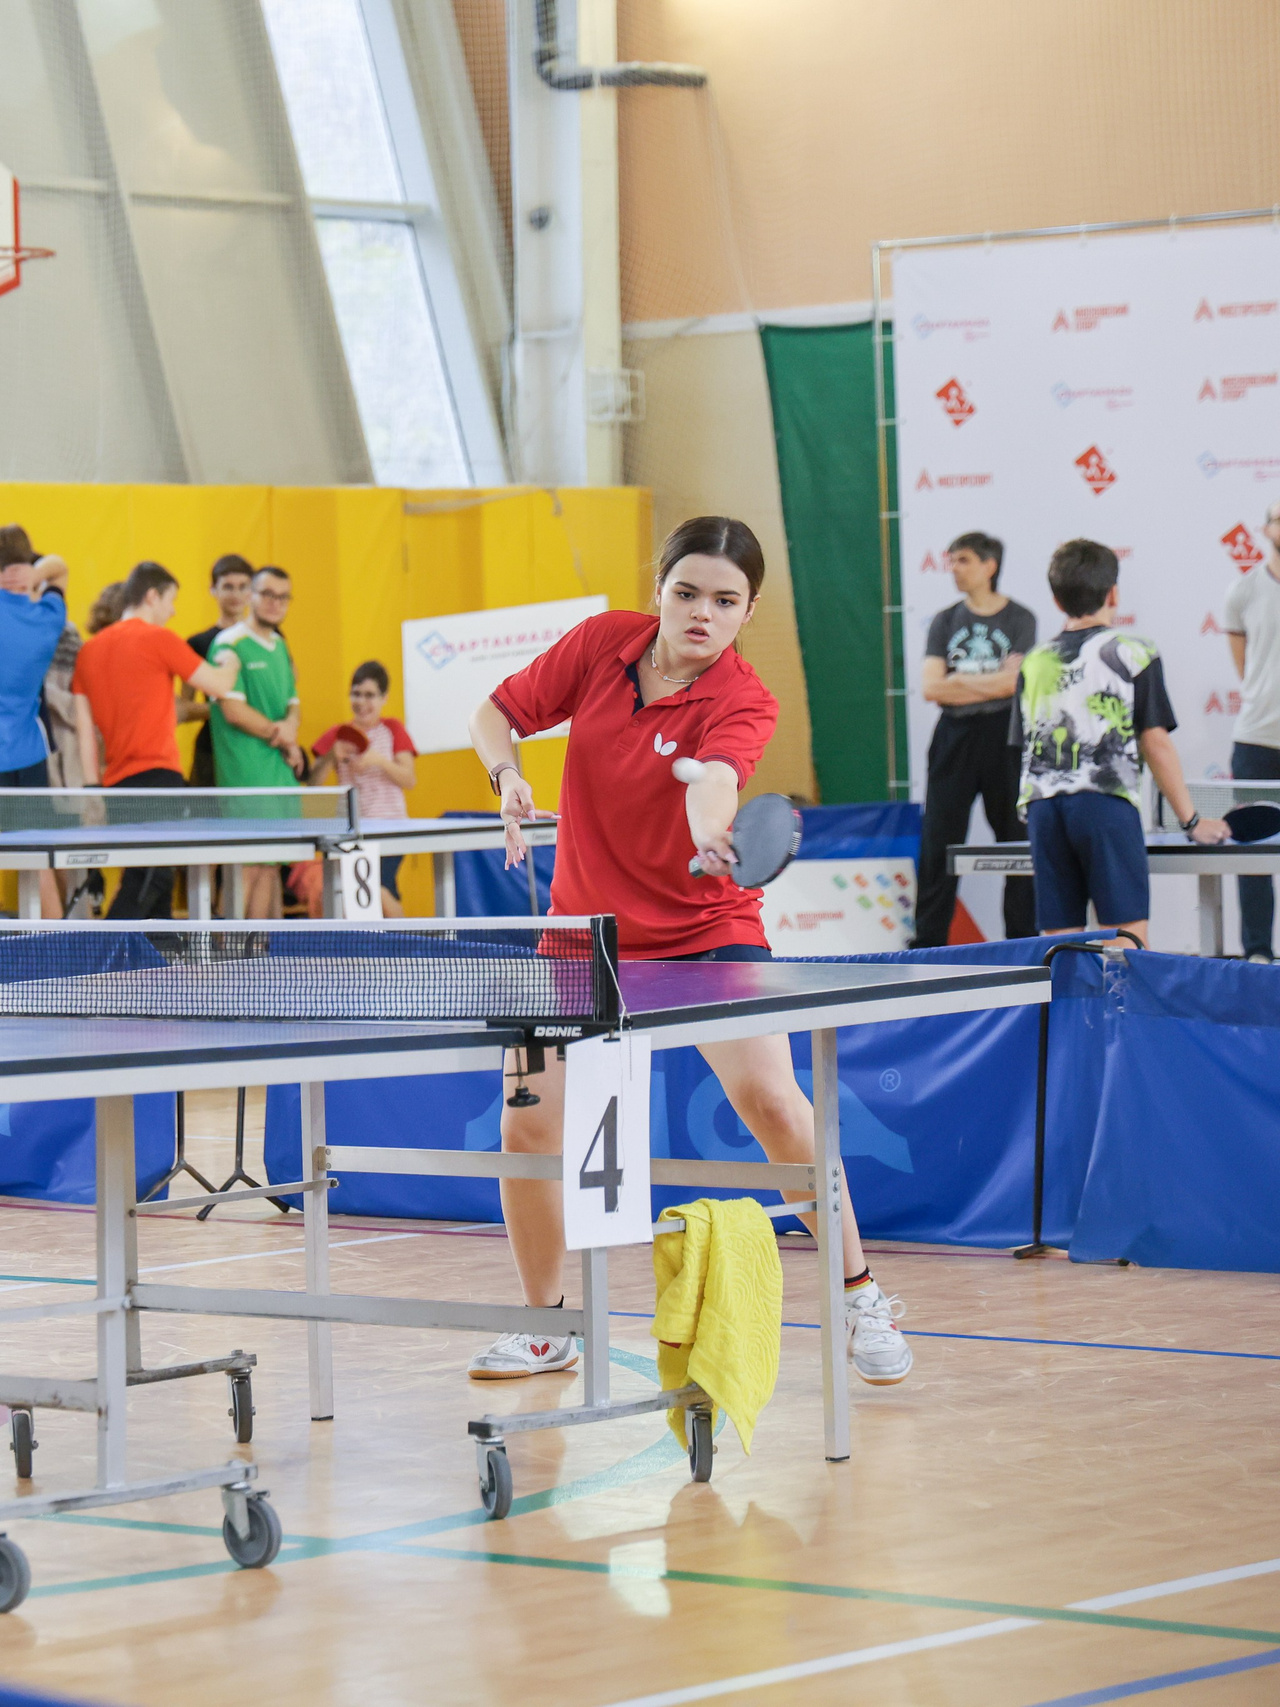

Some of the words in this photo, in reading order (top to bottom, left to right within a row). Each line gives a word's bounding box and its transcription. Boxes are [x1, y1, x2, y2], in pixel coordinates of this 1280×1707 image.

[354, 857, 371, 909] 8
[534, 1026, 583, 1037] DONIC
[579, 1096, 624, 1213] 4
